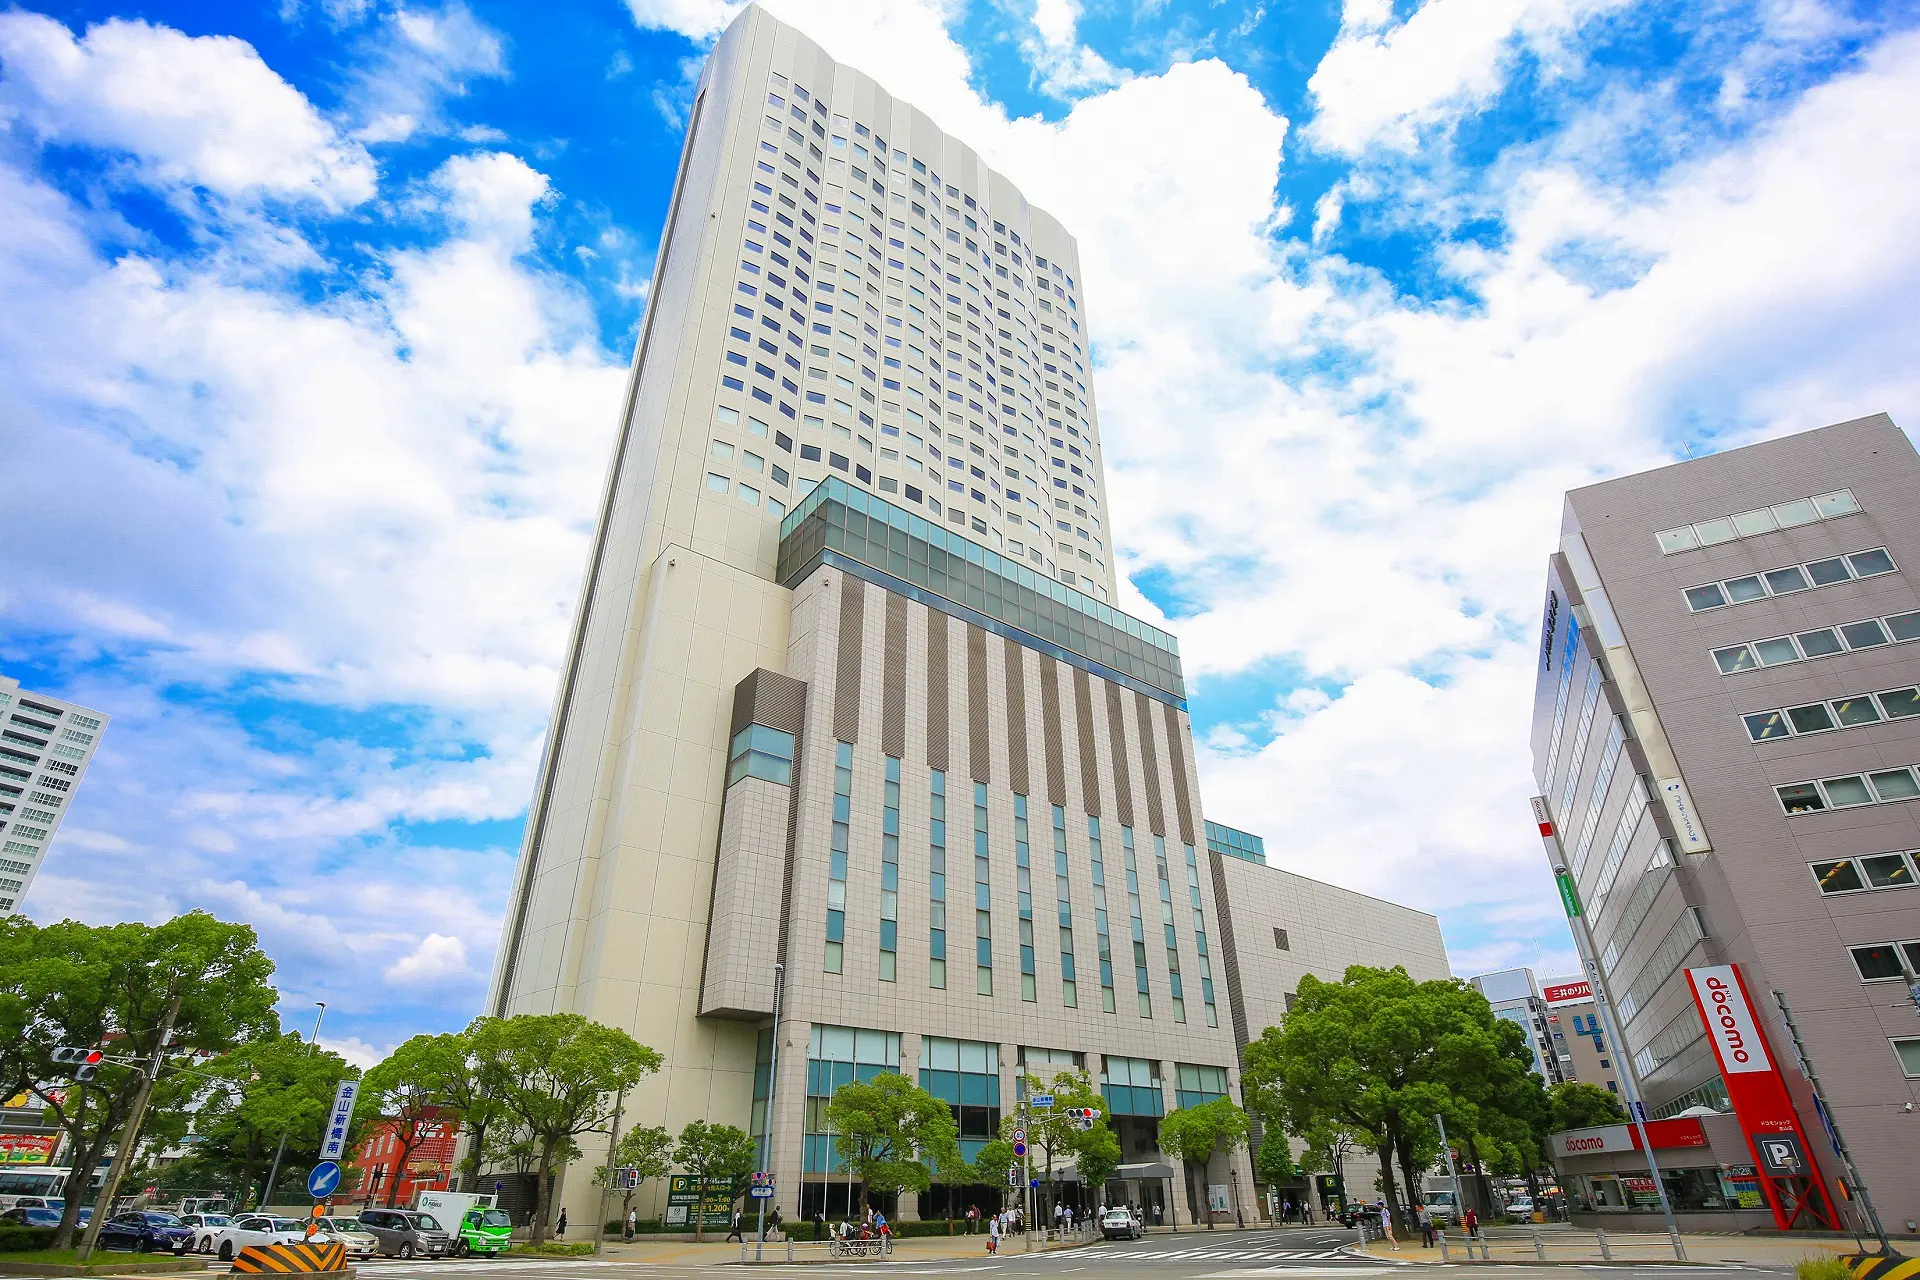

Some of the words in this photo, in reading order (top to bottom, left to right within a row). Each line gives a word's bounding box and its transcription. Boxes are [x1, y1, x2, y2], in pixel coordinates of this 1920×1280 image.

[1725, 987, 1734, 1002] NTT
[1705, 977, 1749, 1063] docomo
[326, 1086, 354, 1154] 金山新橋南
[1565, 1137, 1604, 1151] docomo
[1770, 1144, 1789, 1165] P
[678, 1180, 685, 1189] P
